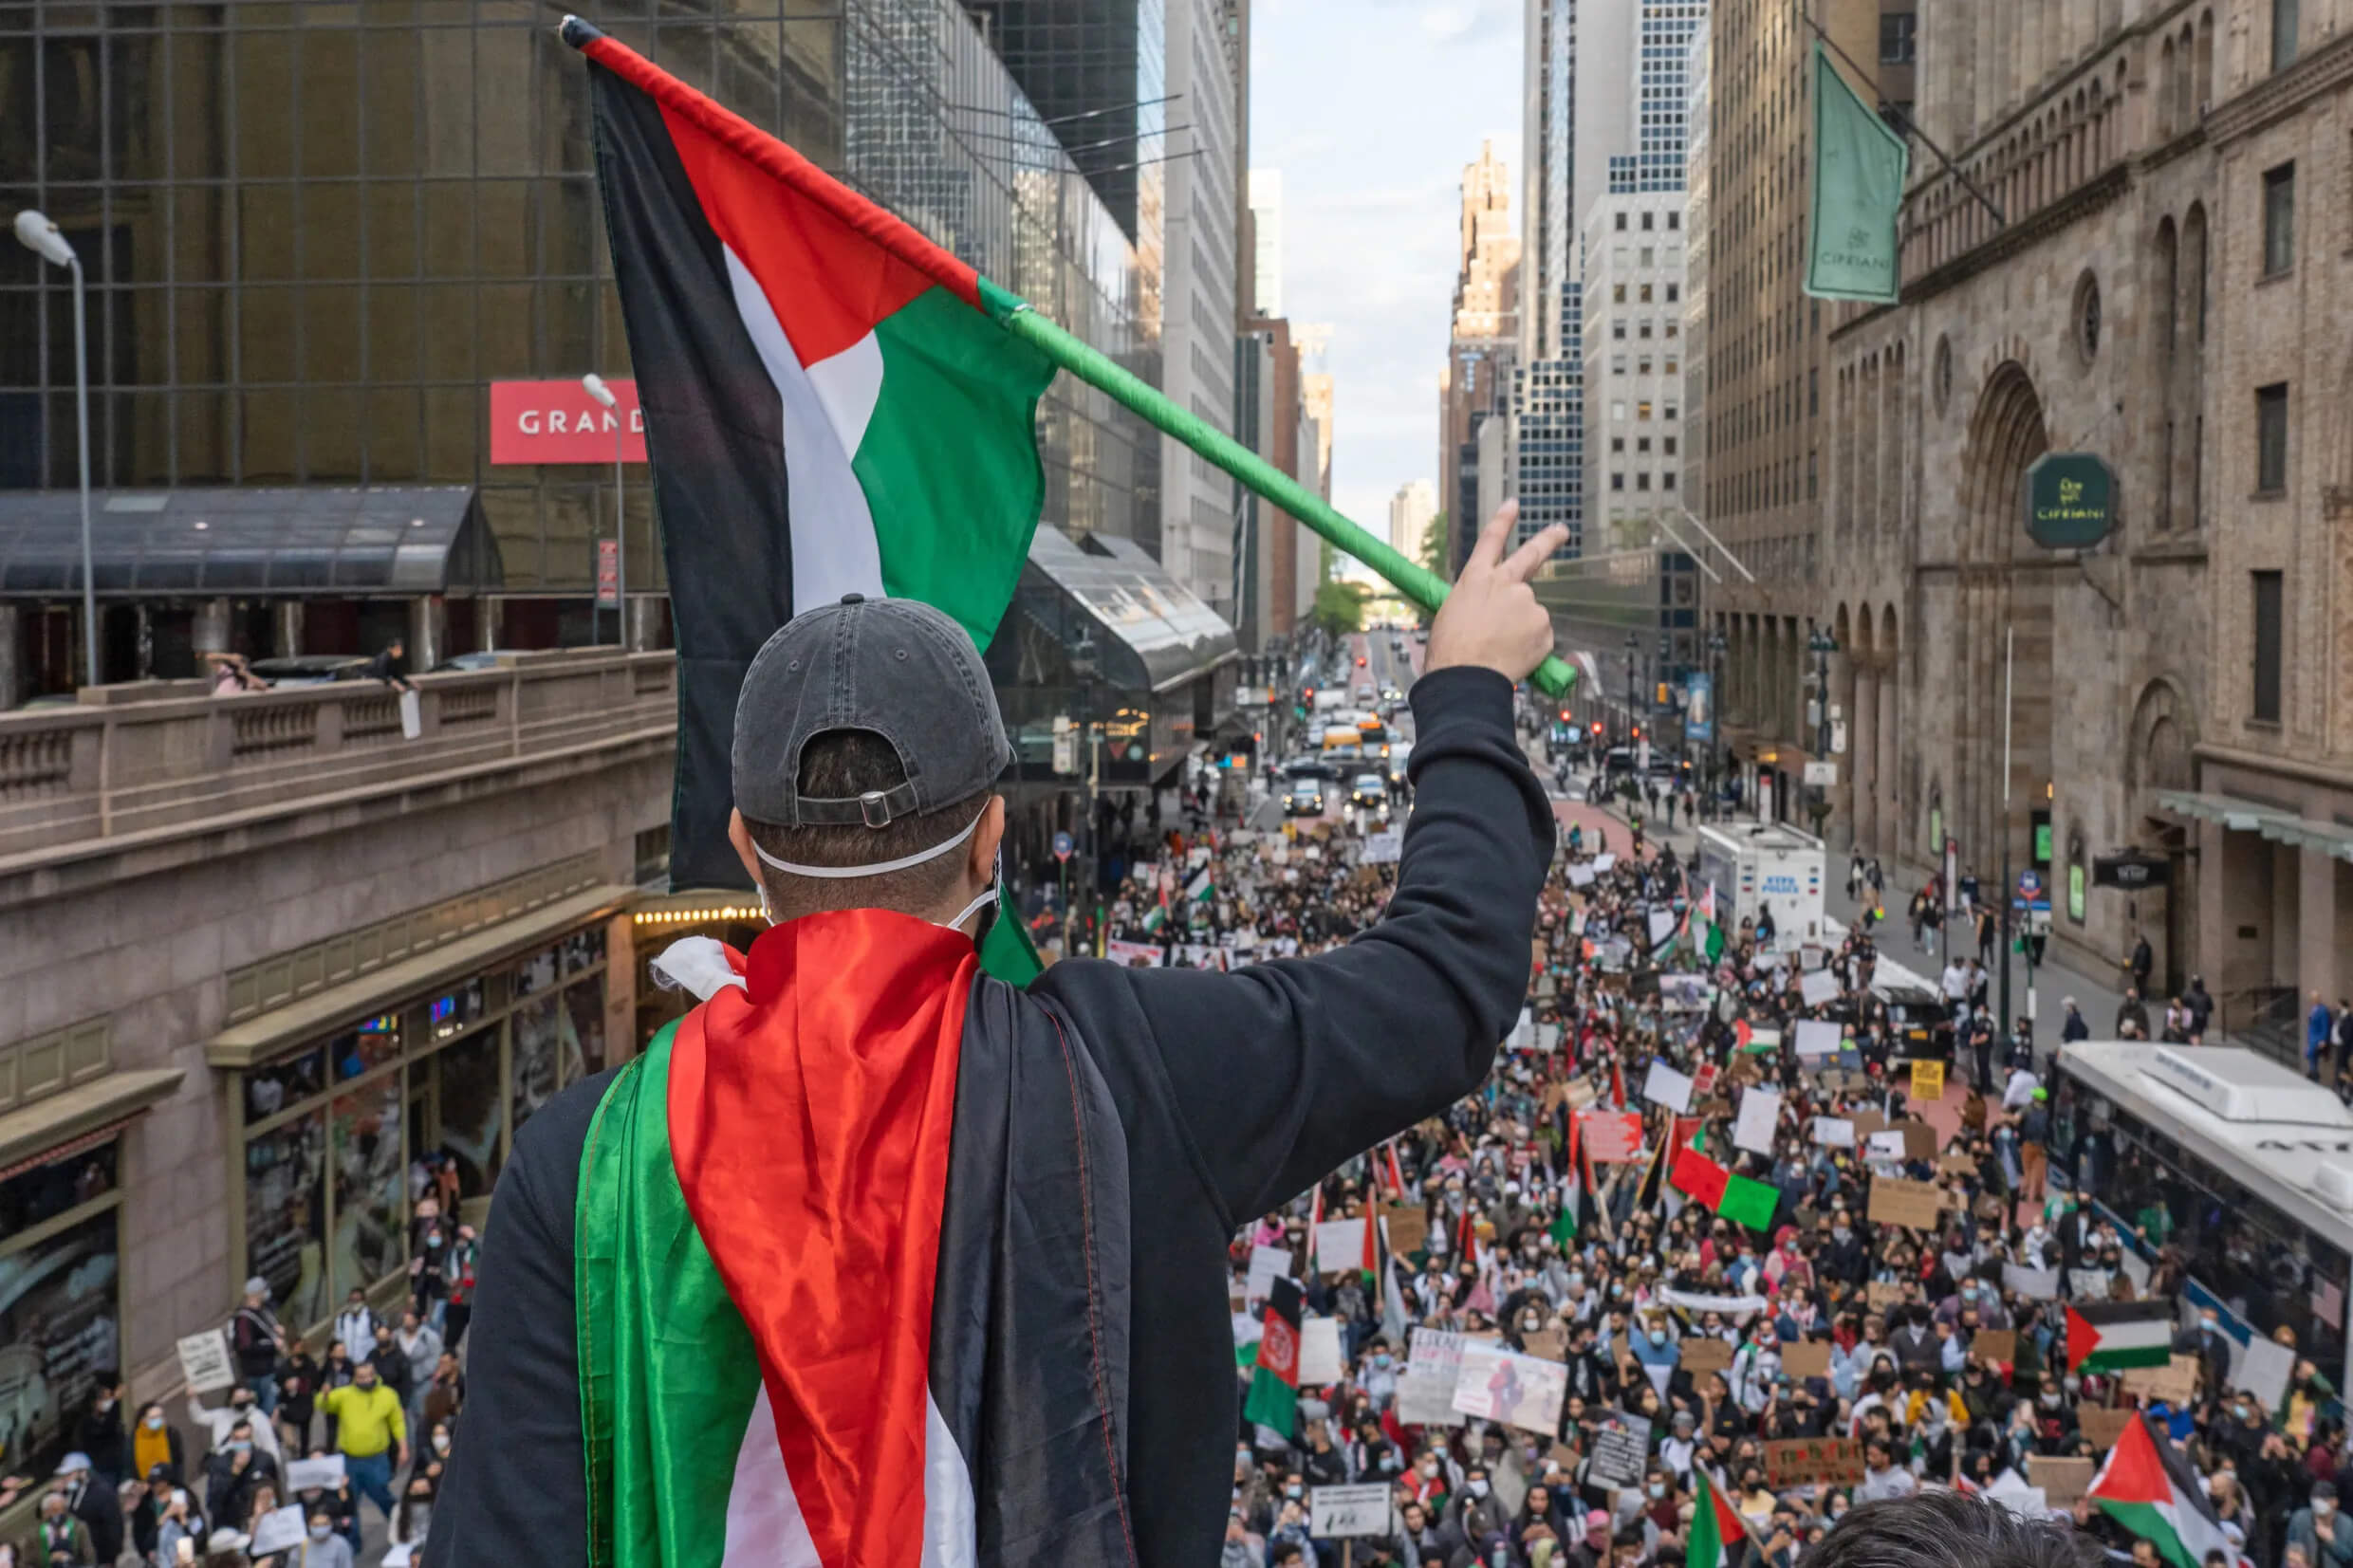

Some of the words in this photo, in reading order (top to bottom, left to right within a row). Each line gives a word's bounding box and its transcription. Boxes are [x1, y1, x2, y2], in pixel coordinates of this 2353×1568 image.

[518, 410, 645, 434] GRAND
[2037, 507, 2104, 521] CIPRIANI
[1761, 884, 1800, 895] POLICE
